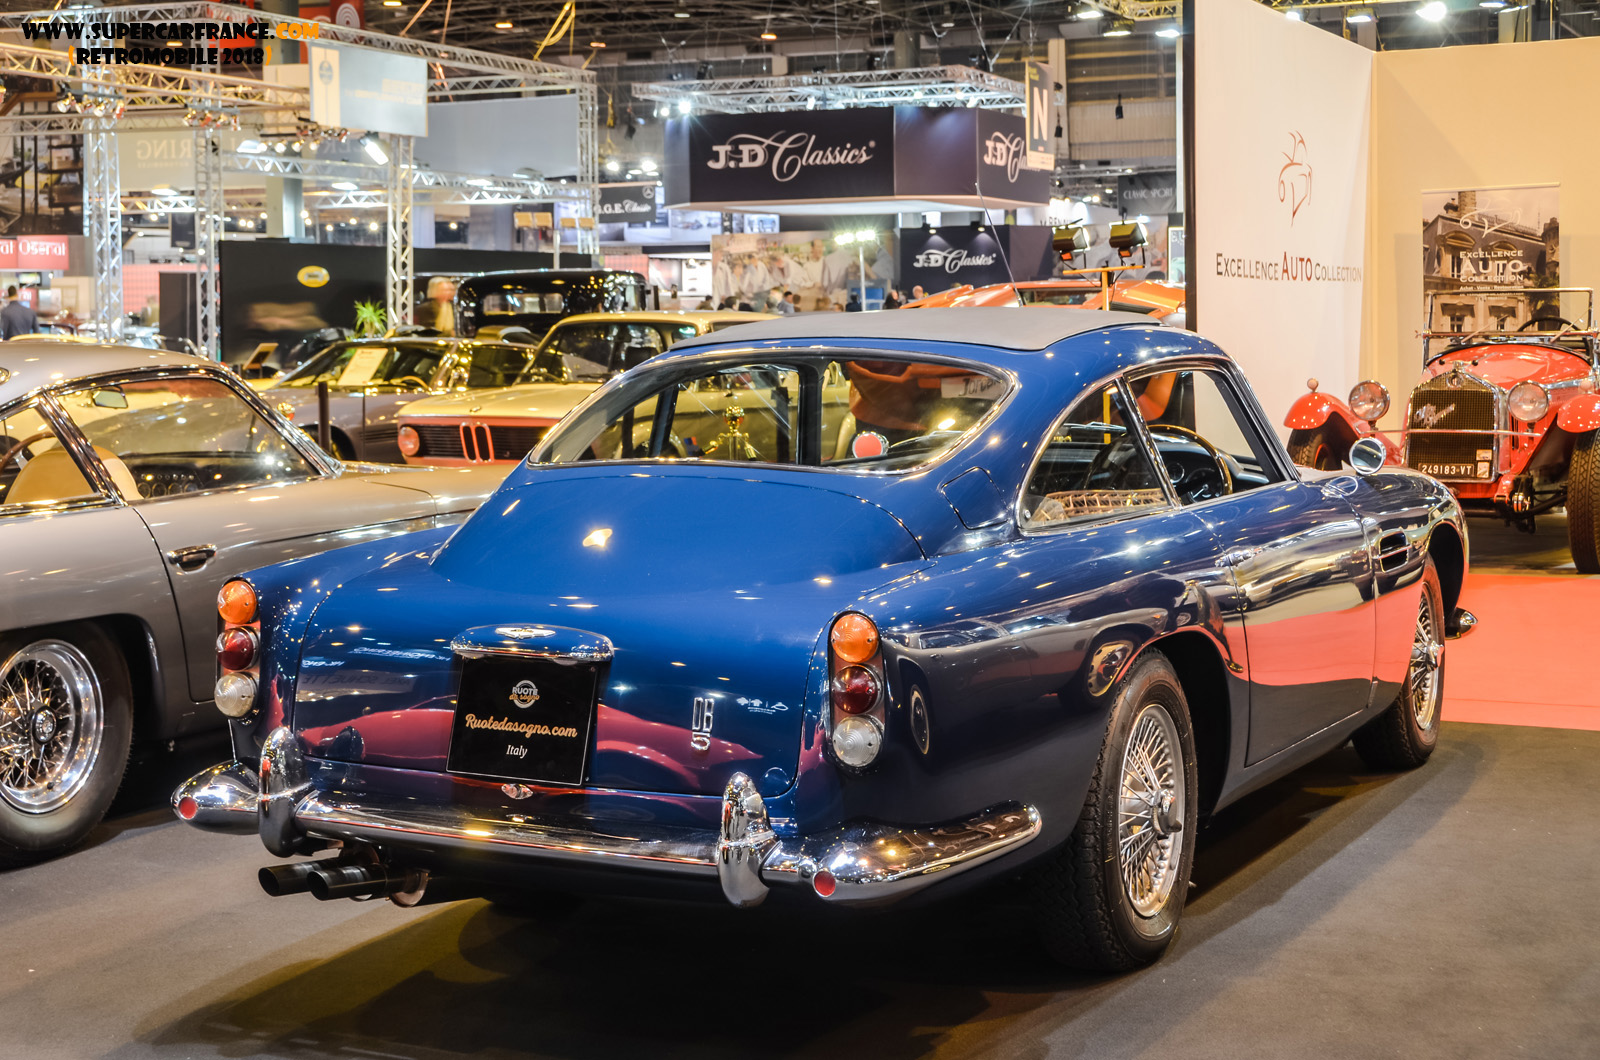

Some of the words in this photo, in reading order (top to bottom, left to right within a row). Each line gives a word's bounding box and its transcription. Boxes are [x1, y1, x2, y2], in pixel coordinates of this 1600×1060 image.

[1033, 86, 1048, 141] N
[766, 131, 873, 182] Classics
[1460, 250, 1523, 258] EXCELLENCE
[1216, 253, 1279, 281] EXCELLENCE
[1281, 251, 1313, 281] AUTO
[1461, 259, 1524, 274] AUTO
[512, 686, 538, 696] RUOTE
[465, 713, 578, 739] Ruotedasogno.com
[506, 744, 528, 759] Italy
